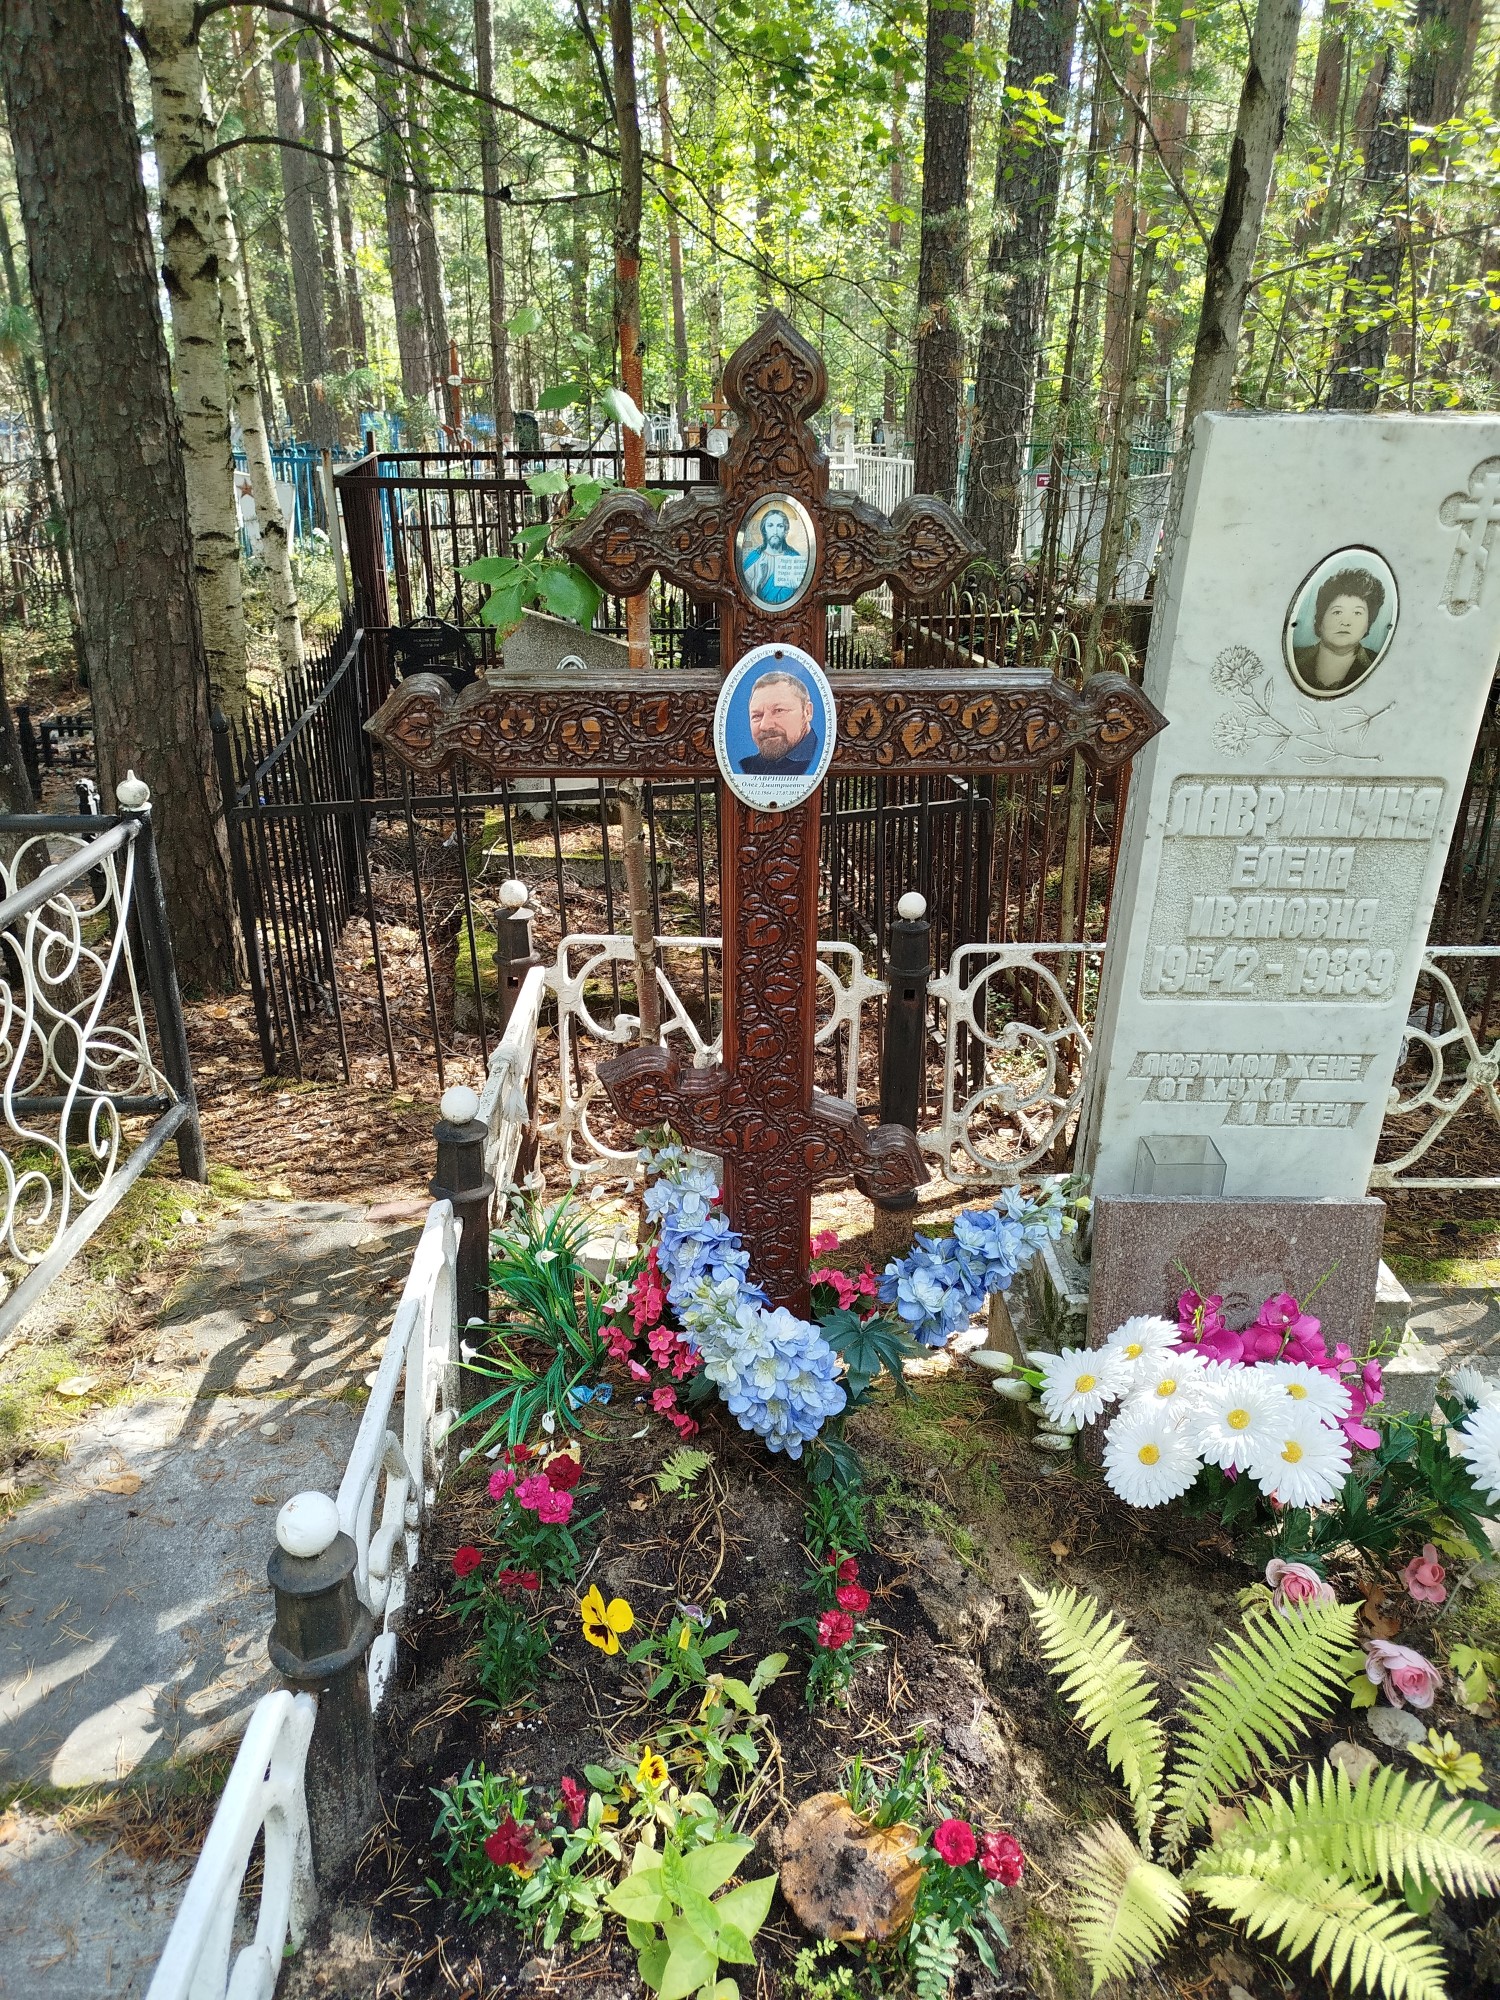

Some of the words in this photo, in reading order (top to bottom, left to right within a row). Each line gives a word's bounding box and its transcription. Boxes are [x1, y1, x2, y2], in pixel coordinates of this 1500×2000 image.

[759, 781, 805, 789] Дмитриевич
[1163, 785, 1443, 839] ЛАВРИШИНА
[1230, 846, 1356, 890] ЕЛЕНА
[1186, 896, 1379, 940] ИВАНОВНА
[1282, 1055, 1363, 1079] ЖЕНЕ
[1157, 1078, 1194, 1100] ОТ
[1201, 1078, 1287, 1101] МУЖА
[1238, 1102, 1258, 1125] И
